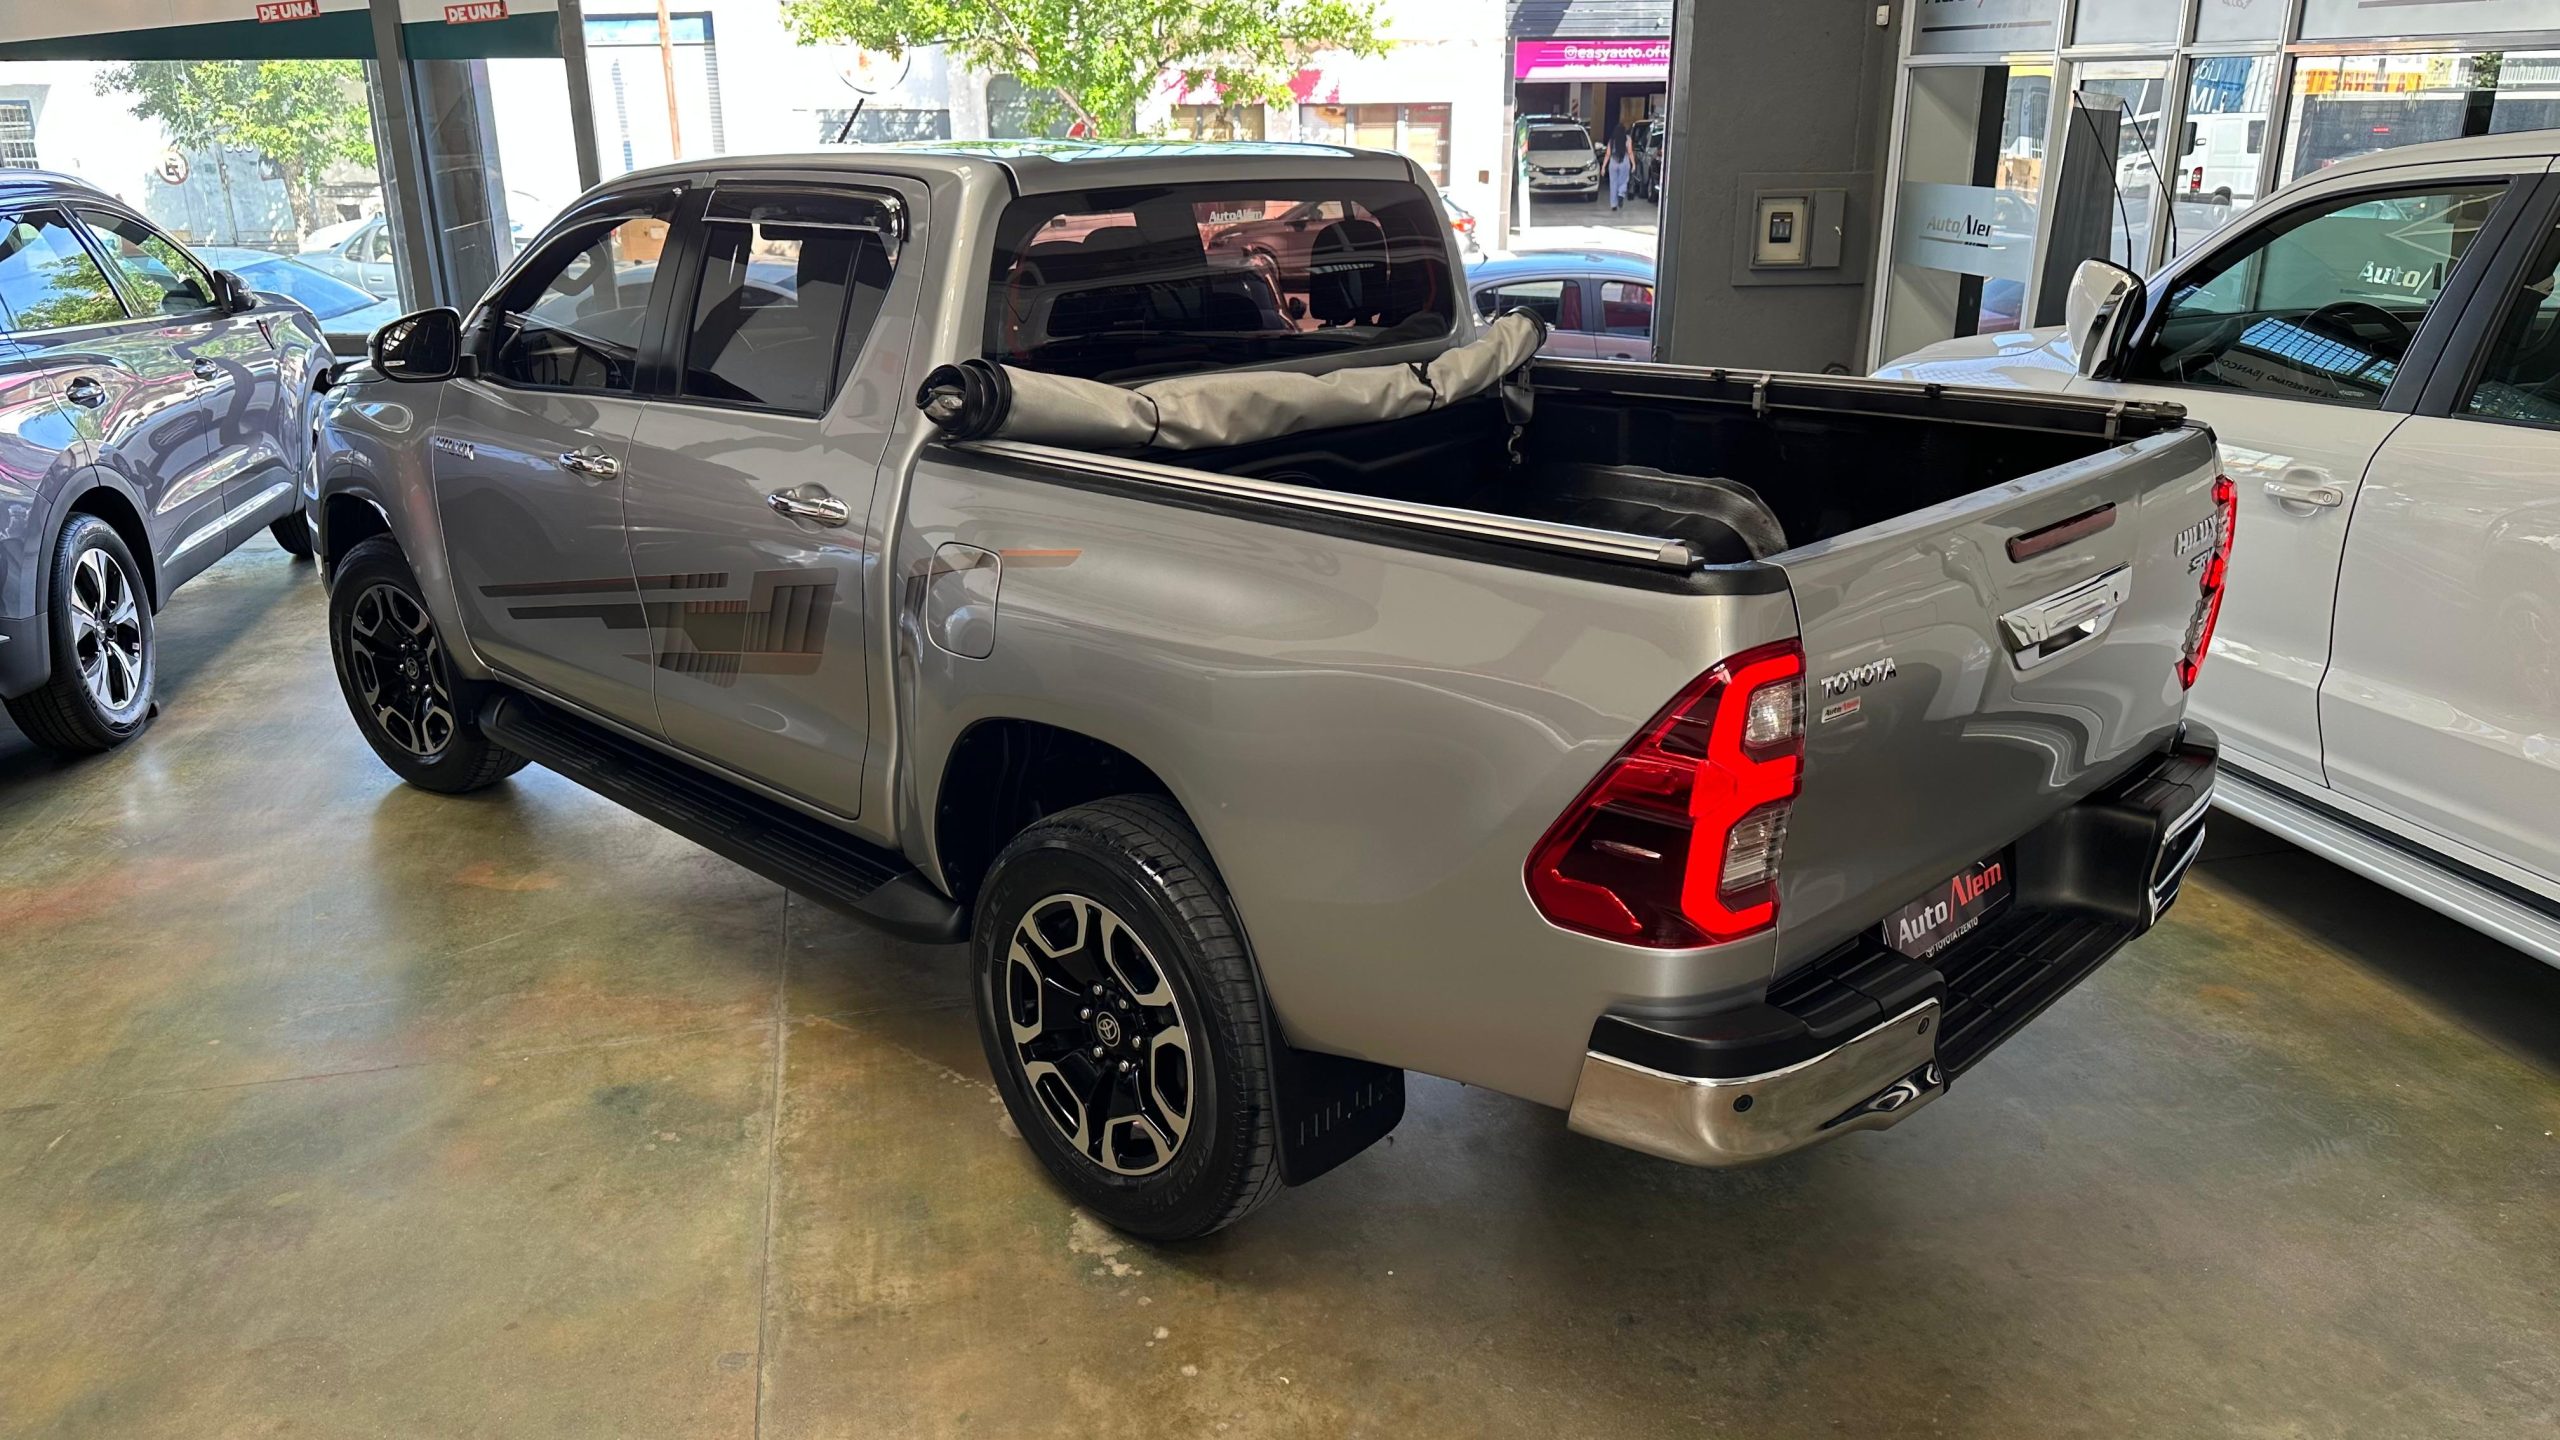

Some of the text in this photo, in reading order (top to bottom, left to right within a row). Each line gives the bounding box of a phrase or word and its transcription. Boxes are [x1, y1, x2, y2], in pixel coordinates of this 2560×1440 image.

[259, 5, 280, 21] DE
[448, 6, 468, 22] DE
[2174, 513, 2218, 558] HILUX
[1820, 656, 1897, 700] TOYOTA
